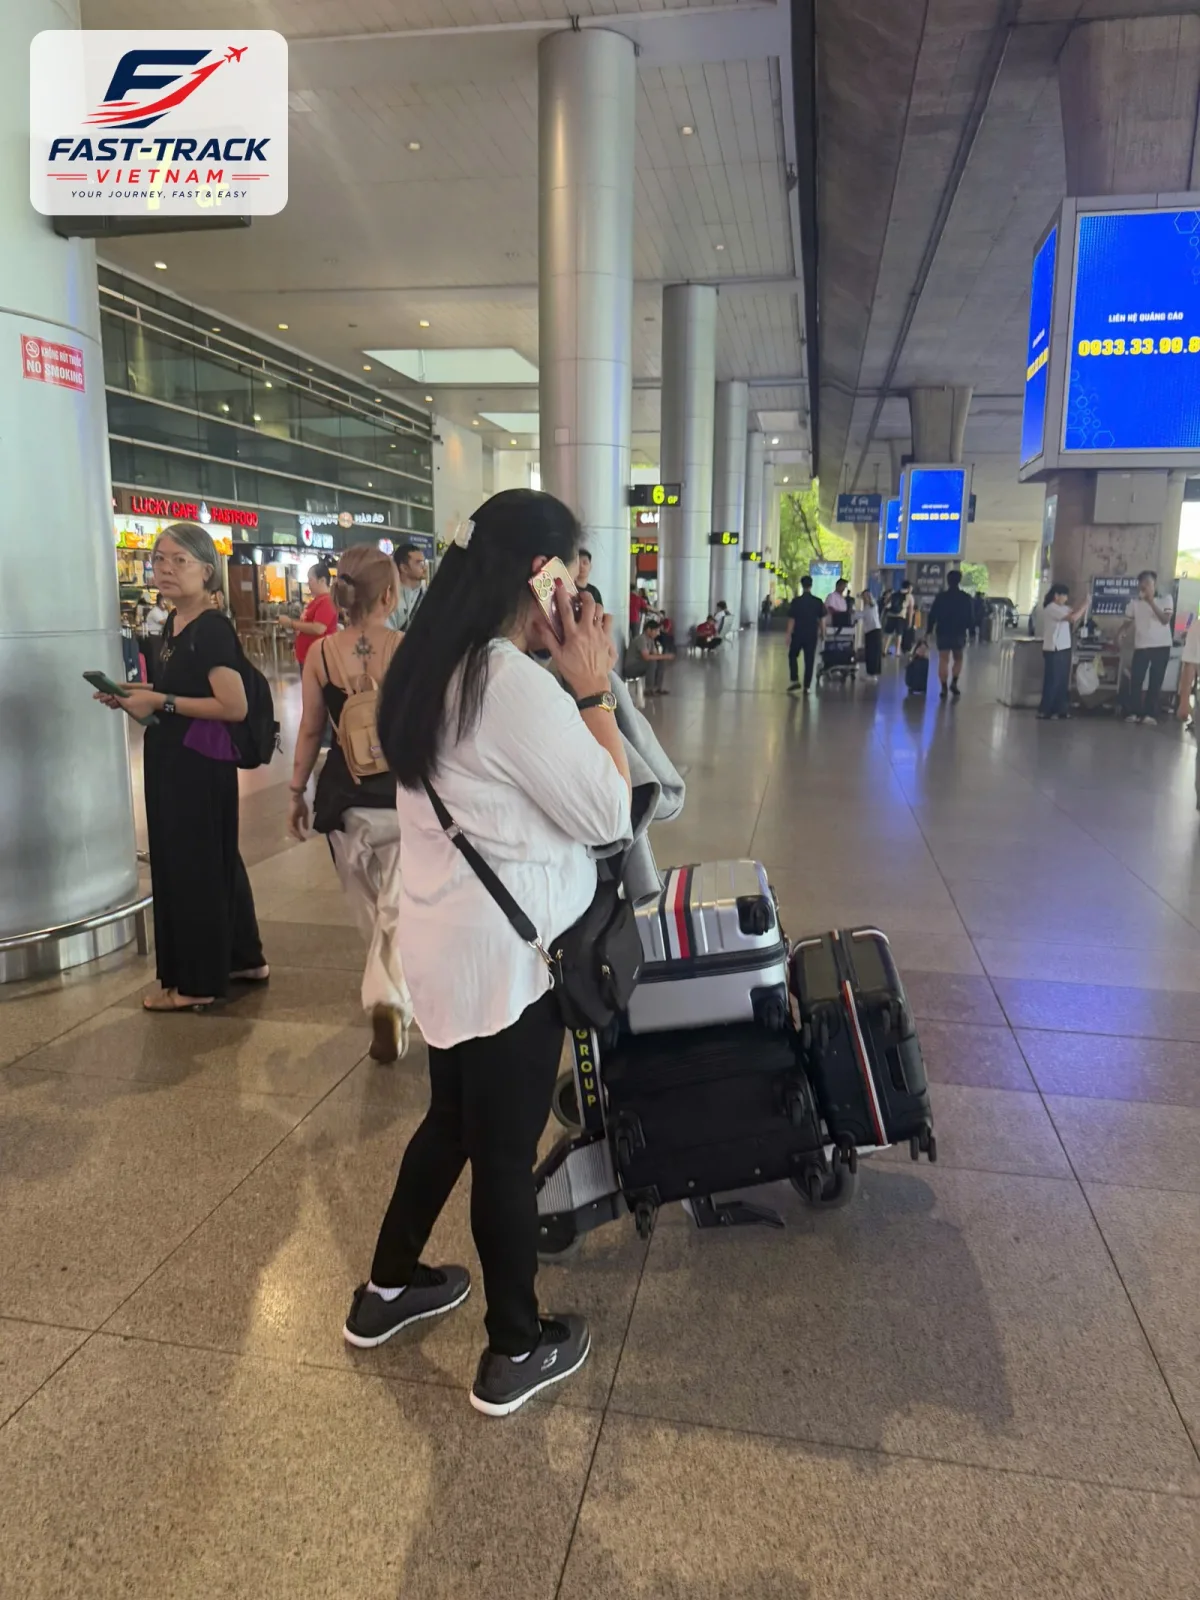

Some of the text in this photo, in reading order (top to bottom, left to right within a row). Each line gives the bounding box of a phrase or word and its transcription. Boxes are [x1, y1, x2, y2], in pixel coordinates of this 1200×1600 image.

[26, 359, 83, 384] NO SMOKING
[653, 485, 665, 505] 6
[131, 495, 170, 516] LUCKY
[171, 502, 199, 520] CAFE
[211, 507, 259, 527] FASTFOOD
[576, 1029, 597, 1107] GROUP
